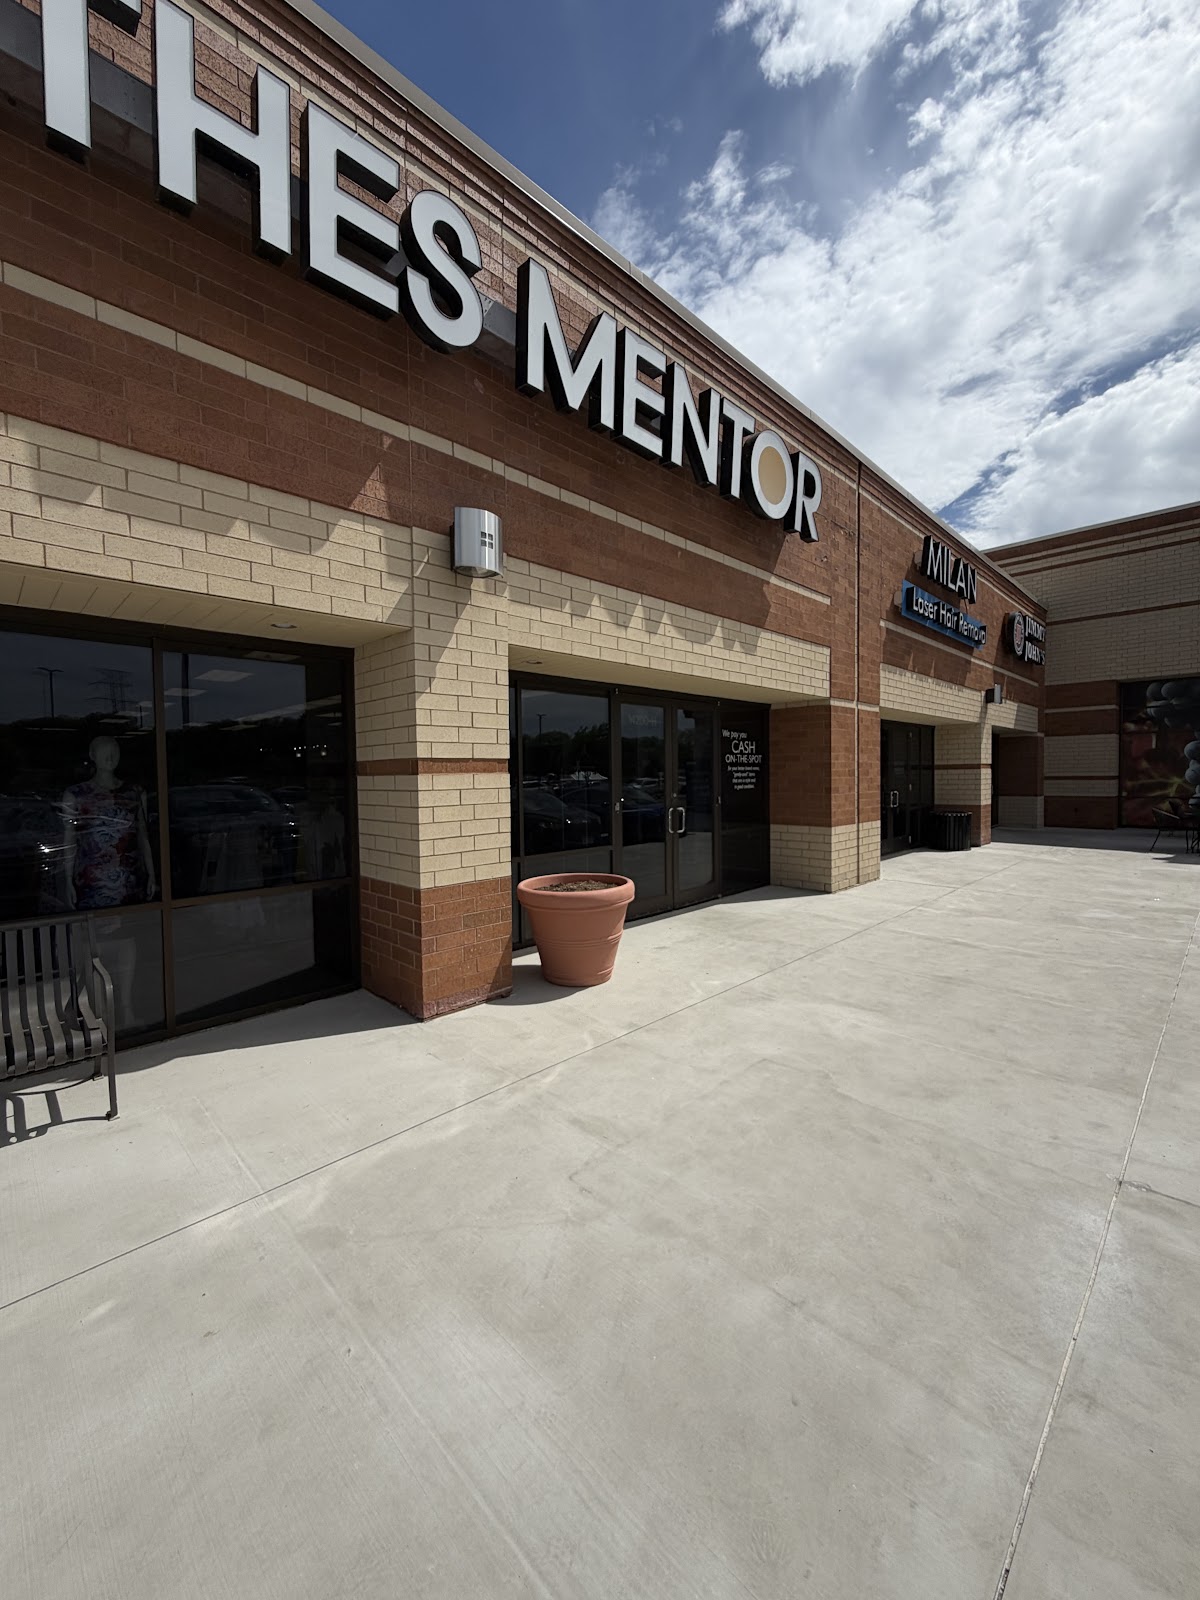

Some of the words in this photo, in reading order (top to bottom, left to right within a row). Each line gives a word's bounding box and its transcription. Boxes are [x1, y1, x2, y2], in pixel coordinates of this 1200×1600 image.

[516, 257, 822, 543] MENTOR
[925, 535, 978, 604] MILAN
[911, 586, 938, 620] Laser
[939, 601, 958, 630] Hair
[722, 729, 730, 738] We
[730, 731, 739, 740] pay
[739, 732, 747, 740] you
[731, 740, 756, 754] CASH
[725, 754, 762, 764] ON-THE-SPOT
